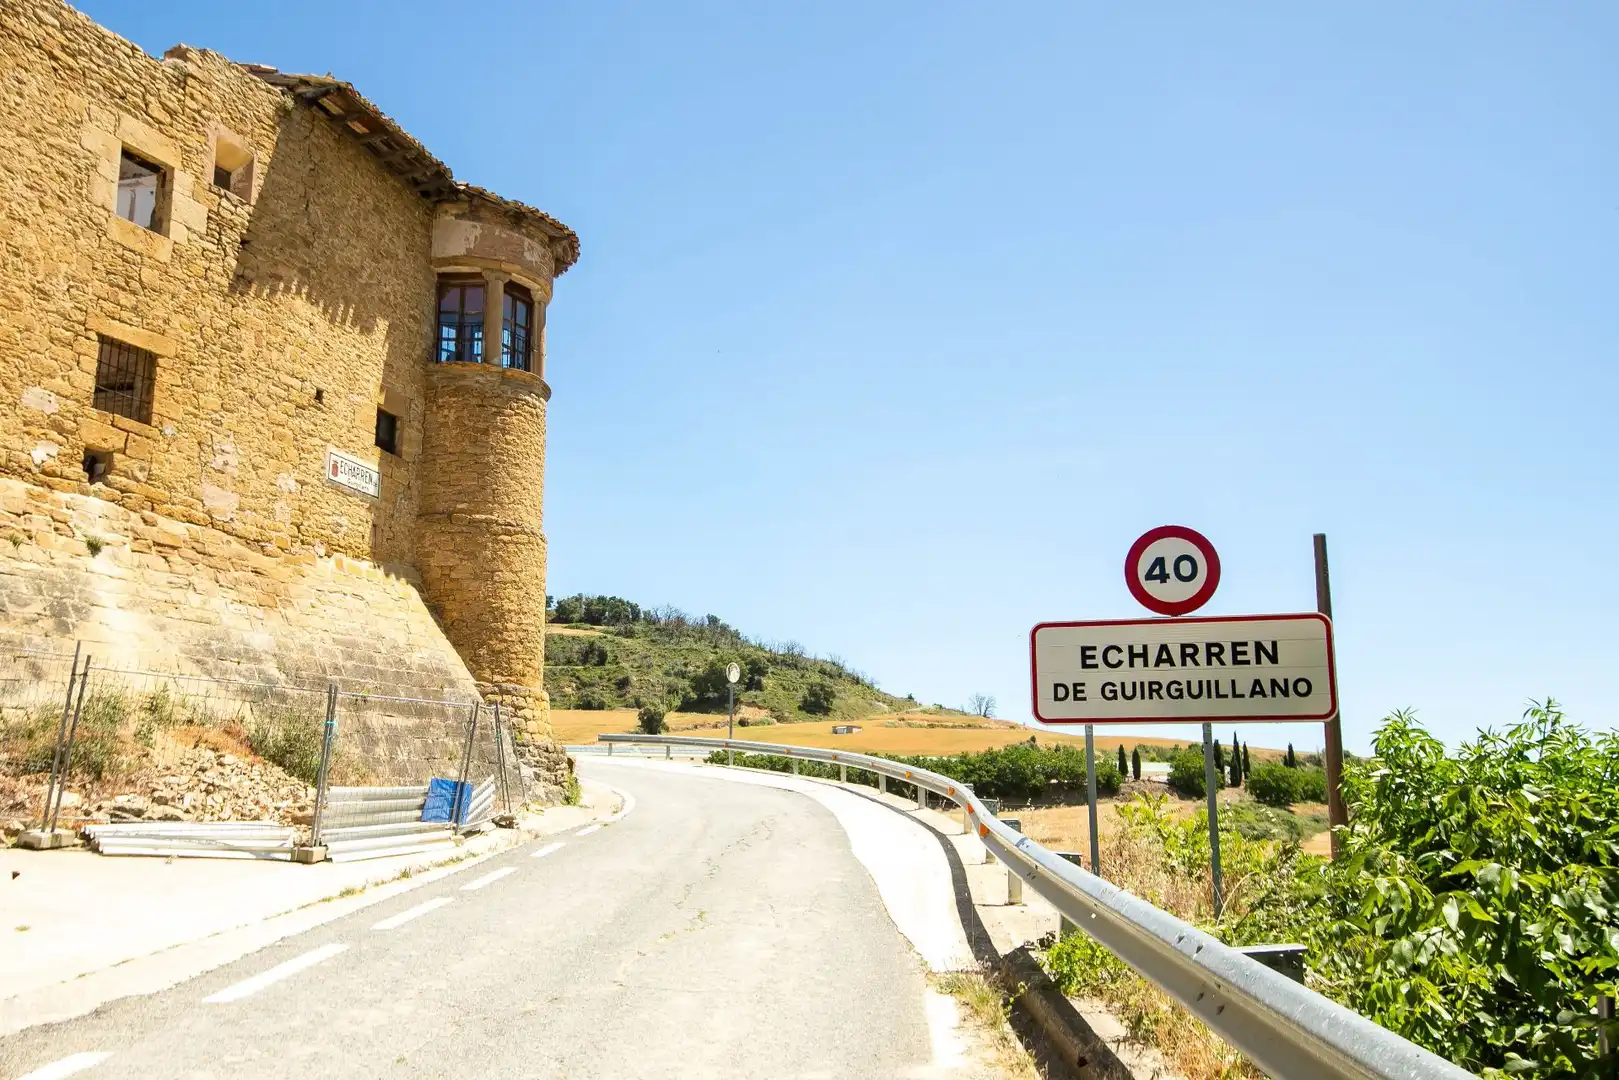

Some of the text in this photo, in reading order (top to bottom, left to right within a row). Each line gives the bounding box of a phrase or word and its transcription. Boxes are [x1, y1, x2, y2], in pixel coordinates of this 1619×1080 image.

[340, 460, 373, 485] ECHARREN
[1144, 554, 1198, 584] 40
[1080, 640, 1279, 669] ECHARREN
[1053, 677, 1313, 702] DE GUIRGUILLANO
